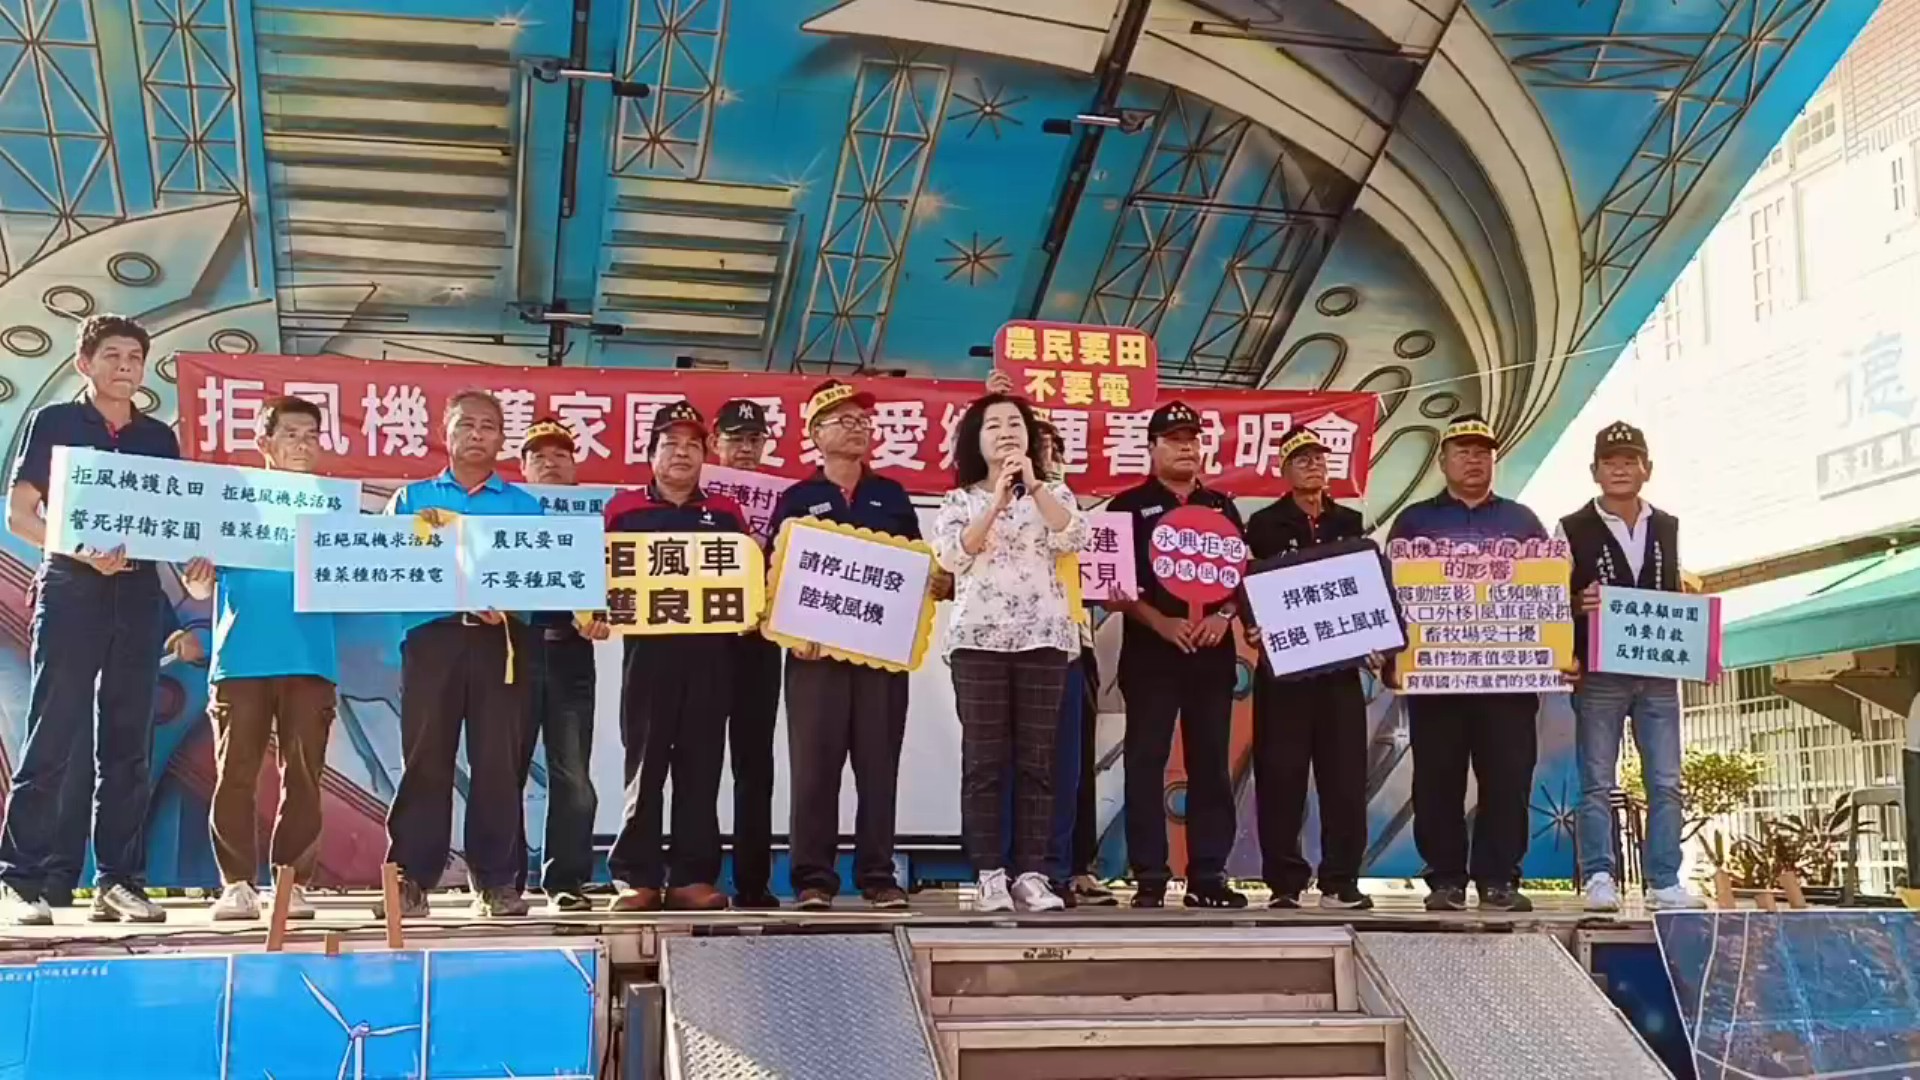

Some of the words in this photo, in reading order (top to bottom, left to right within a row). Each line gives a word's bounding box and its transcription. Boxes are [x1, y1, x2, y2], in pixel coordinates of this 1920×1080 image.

[1005, 326, 1146, 368] 農民要田
[1024, 368, 1131, 407] 不要電
[197, 376, 430, 457] 拒風機
[71, 465, 205, 496] 拒風機護良田
[221, 484, 342, 511] 拒絕風機求活路
[70, 508, 201, 541] 誓死捍衛家園
[491, 529, 574, 549] 農民要田
[1155, 526, 1243, 560] 永興拒絕
[314, 566, 443, 583] 種菜種稻不種電
[481, 570, 586, 590] 不要種風電
[799, 550, 905, 593] 請停止開發
[1444, 560, 1511, 580] 的影響
[798, 586, 884, 625] 陸域風機
[1282, 576, 1358, 610] 捍衛家園
[1268, 626, 1310, 653] 拒絕
[1314, 607, 1389, 641] 陸上風車
[1403, 604, 1473, 622] 人口外移
[1425, 624, 1536, 642] 畜牧場受干擾
[1417, 650, 1549, 666] 農作物產值受影響
